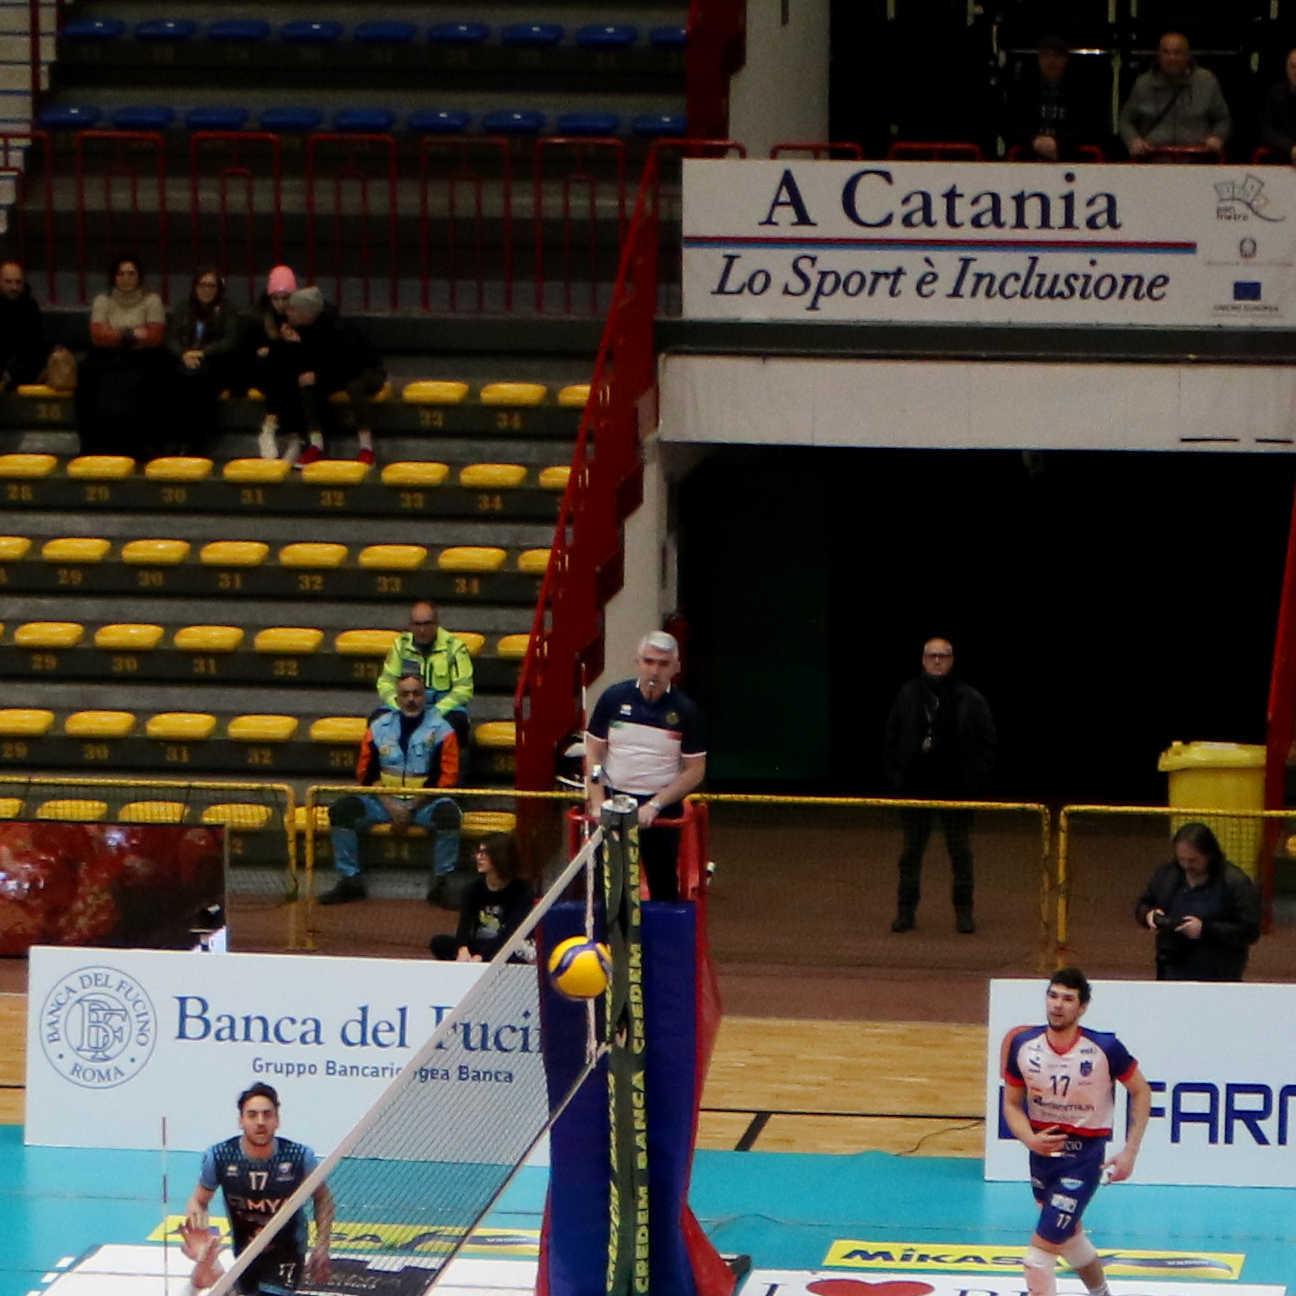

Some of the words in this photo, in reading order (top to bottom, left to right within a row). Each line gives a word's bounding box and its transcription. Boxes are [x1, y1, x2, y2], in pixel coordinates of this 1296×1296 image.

[758, 168, 817, 227] A
[841, 170, 1123, 231] Catania
[710, 255, 772, 297] Lo
[783, 256, 909, 310] Sport
[915, 256, 938, 297] è
[950, 258, 1171, 302] Inclusione
[628, 825, 642, 928] BANCA
[79, 971, 113, 991] DEL
[628, 942, 646, 1055] CREDEM
[174, 995, 325, 1047] Banca
[340, 1005, 409, 1050] del
[70, 1065, 126, 1084] ROMA
[252, 1057, 318, 1077] Gruppo
[413, 1066, 450, 1083] gea
[458, 1065, 513, 1084] Banca
[1048, 1075, 1071, 1098] 17
[632, 1070, 647, 1171] BANCA
[247, 1170, 269, 1191] 17
[634, 1187, 649, 1295] CREDEM
[1055, 1212, 1073, 1231] 17
